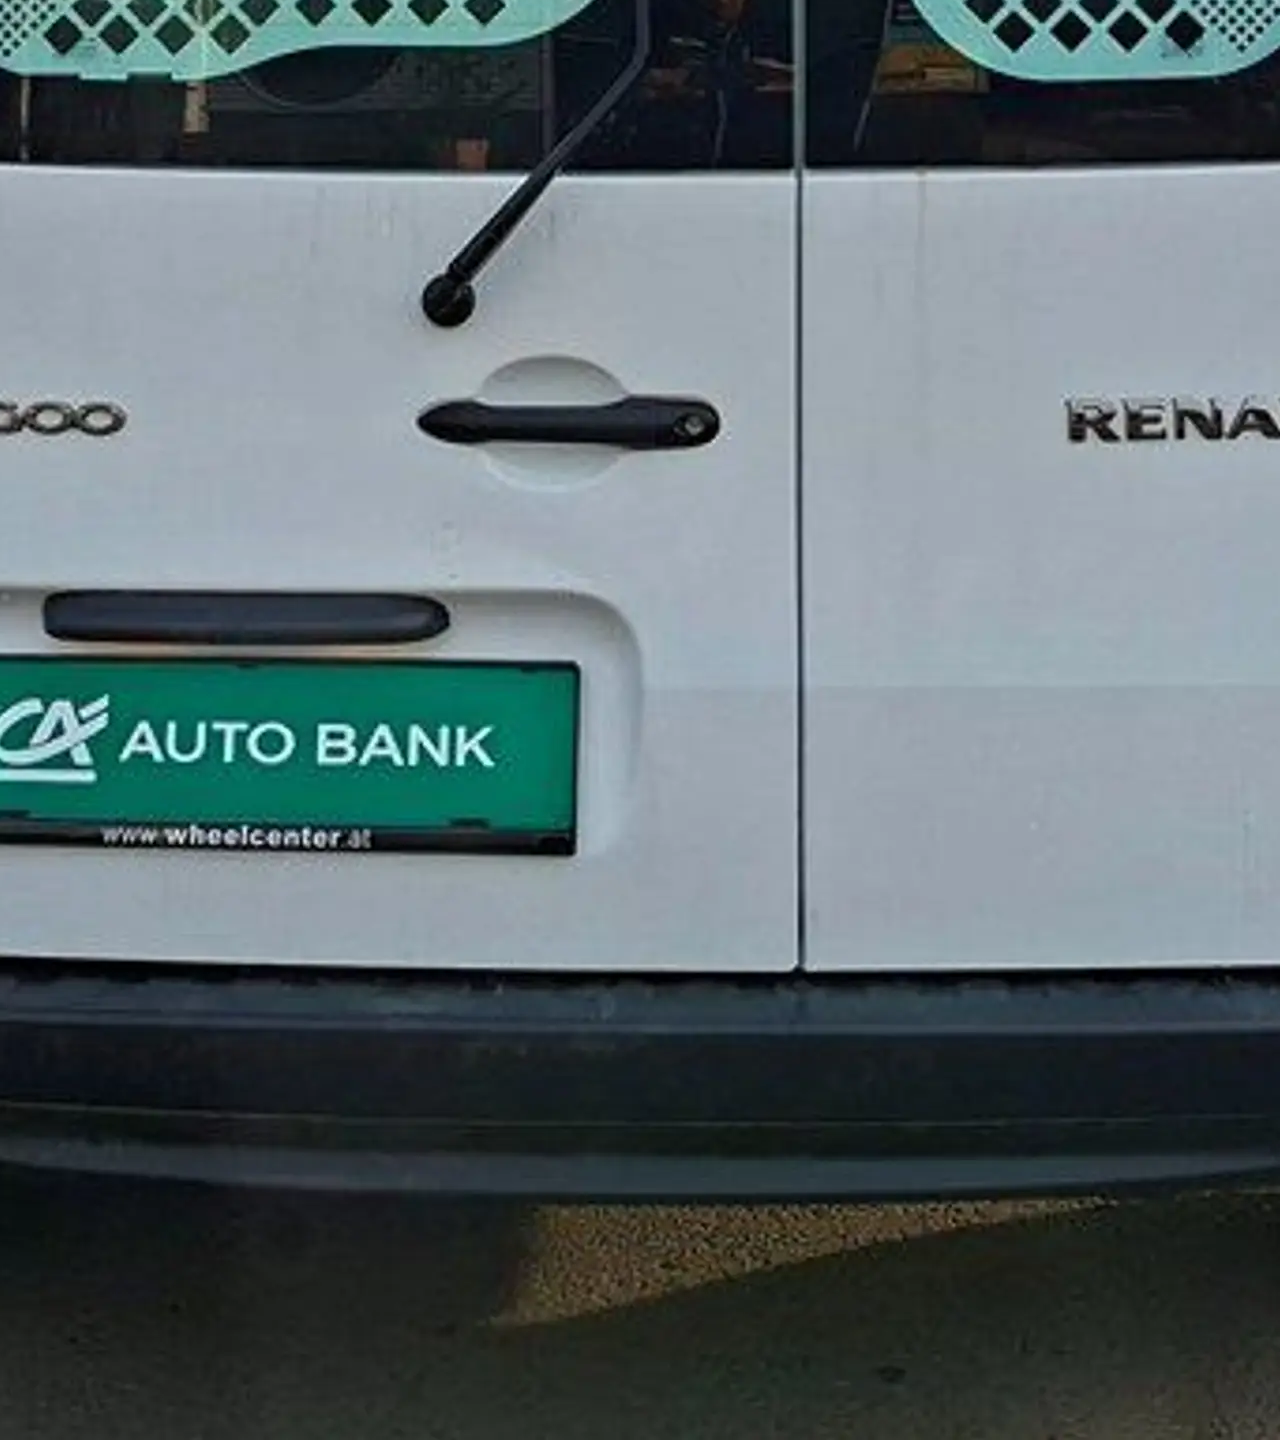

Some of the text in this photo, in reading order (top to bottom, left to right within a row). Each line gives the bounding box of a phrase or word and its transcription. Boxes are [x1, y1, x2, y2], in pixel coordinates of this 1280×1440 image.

[119, 720, 297, 764] AUTO
[317, 721, 496, 768] BANK
[100, 824, 373, 850] www.wheelcenter.at
